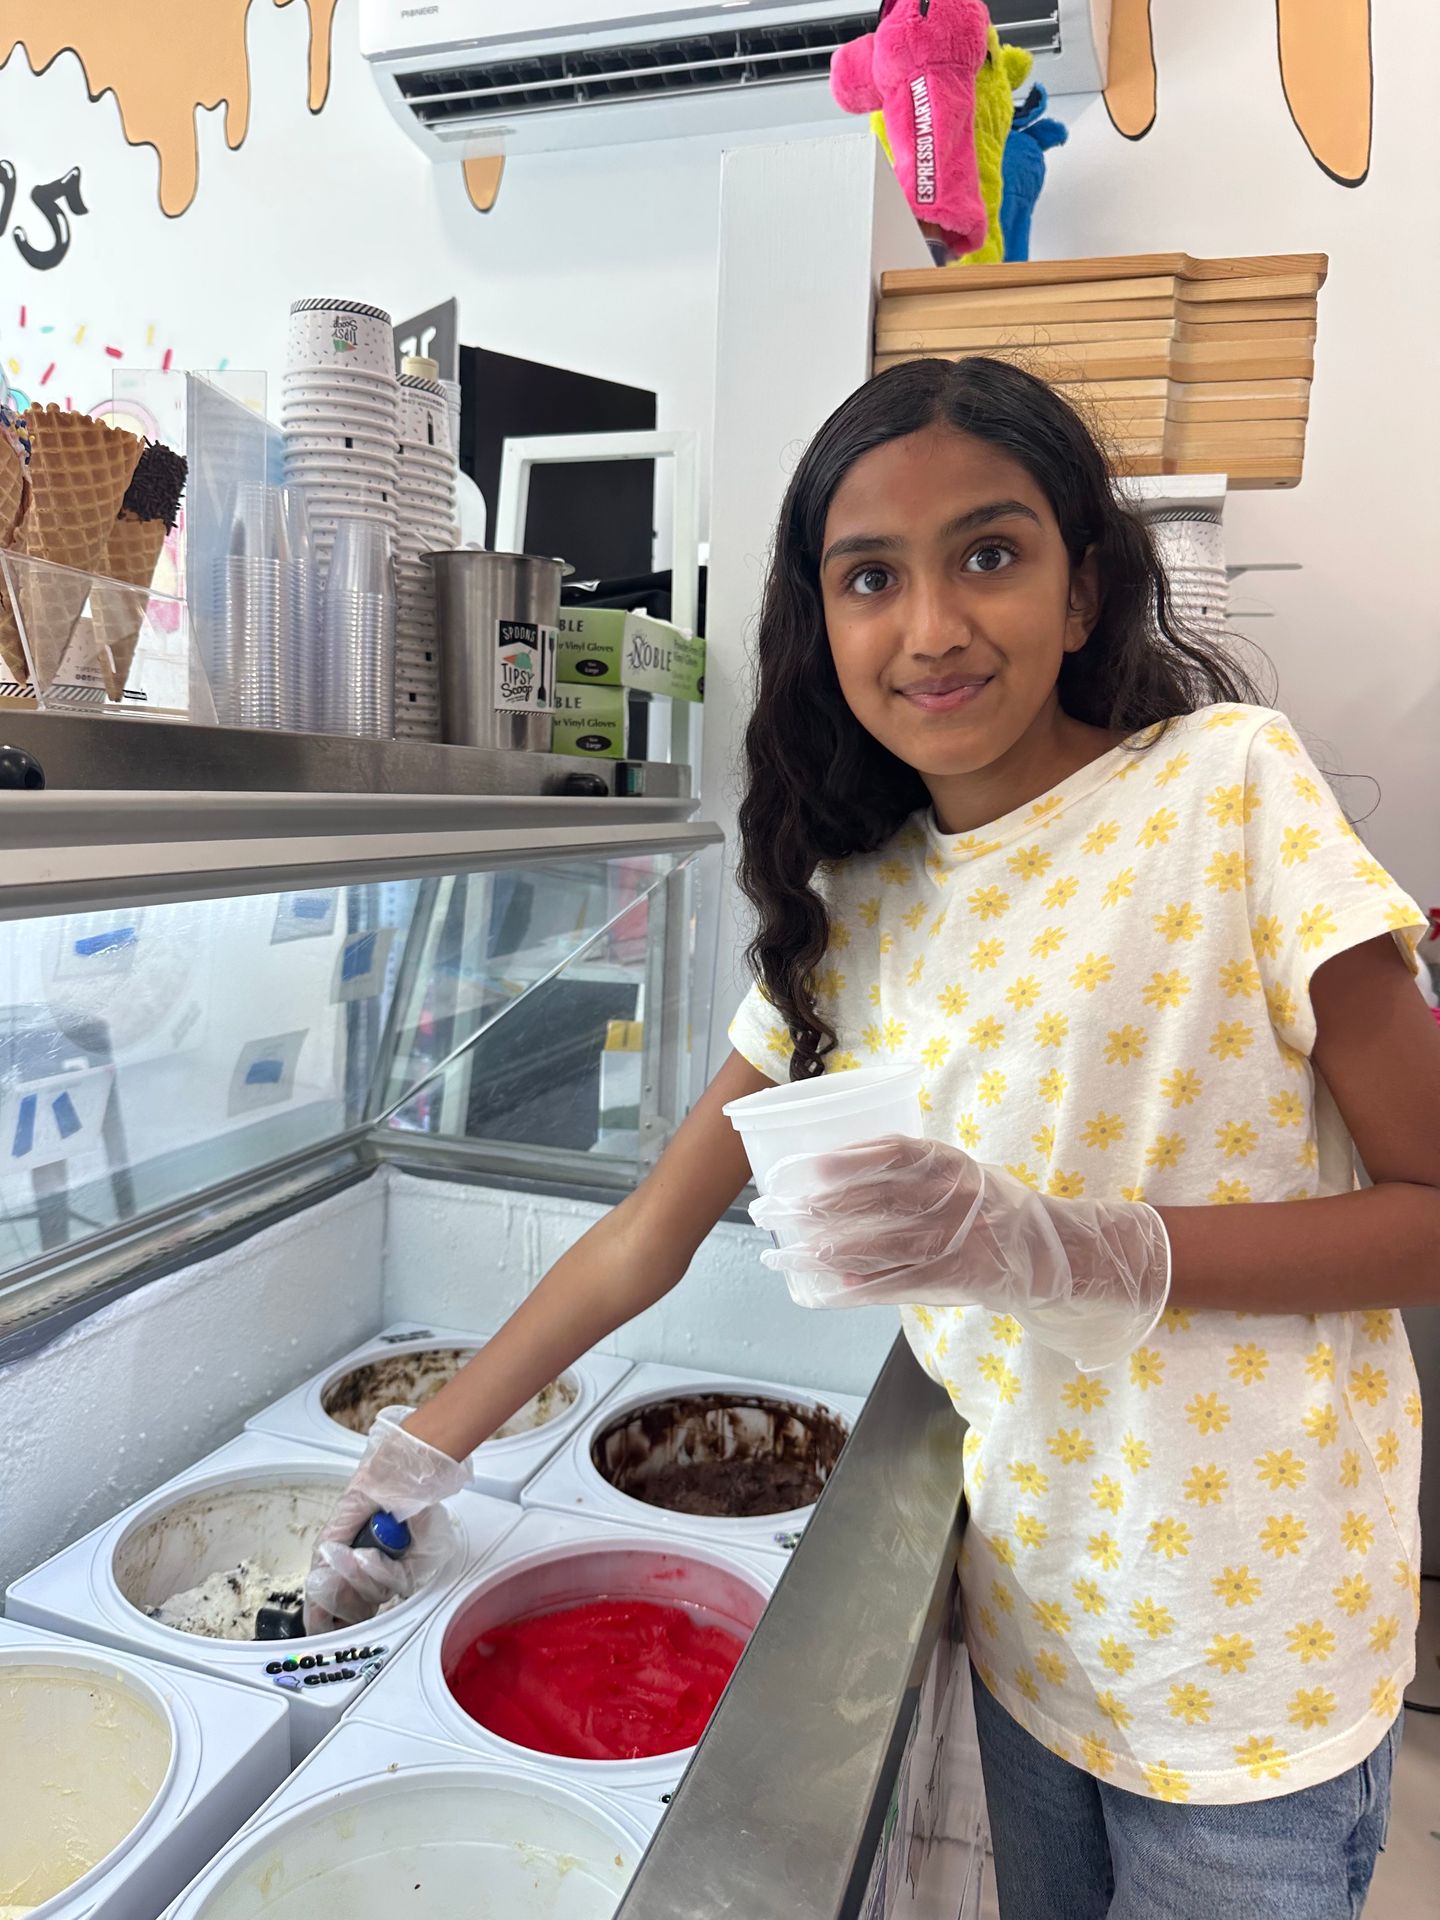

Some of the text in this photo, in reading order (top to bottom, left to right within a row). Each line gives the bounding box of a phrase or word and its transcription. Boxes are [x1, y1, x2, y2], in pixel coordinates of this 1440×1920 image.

[909, 75, 935, 203] ESPRESSO MARTINI
[331, 328, 358, 346] TIPSY
[502, 626, 537, 642] SPOONS
[559, 619, 584, 632] BLE
[564, 641, 585, 653] Vinyl
[586, 642, 614, 652] Gloves
[630, 635, 672, 672] NOBLE
[501, 663, 535, 685] TIPSY
[501, 683, 533, 702] Scoop
[555, 696, 582, 709] BLE
[563, 718, 585, 729] Vinyl
[587, 718, 616, 728] Gloves
[266, 1654, 330, 1674] COOL
